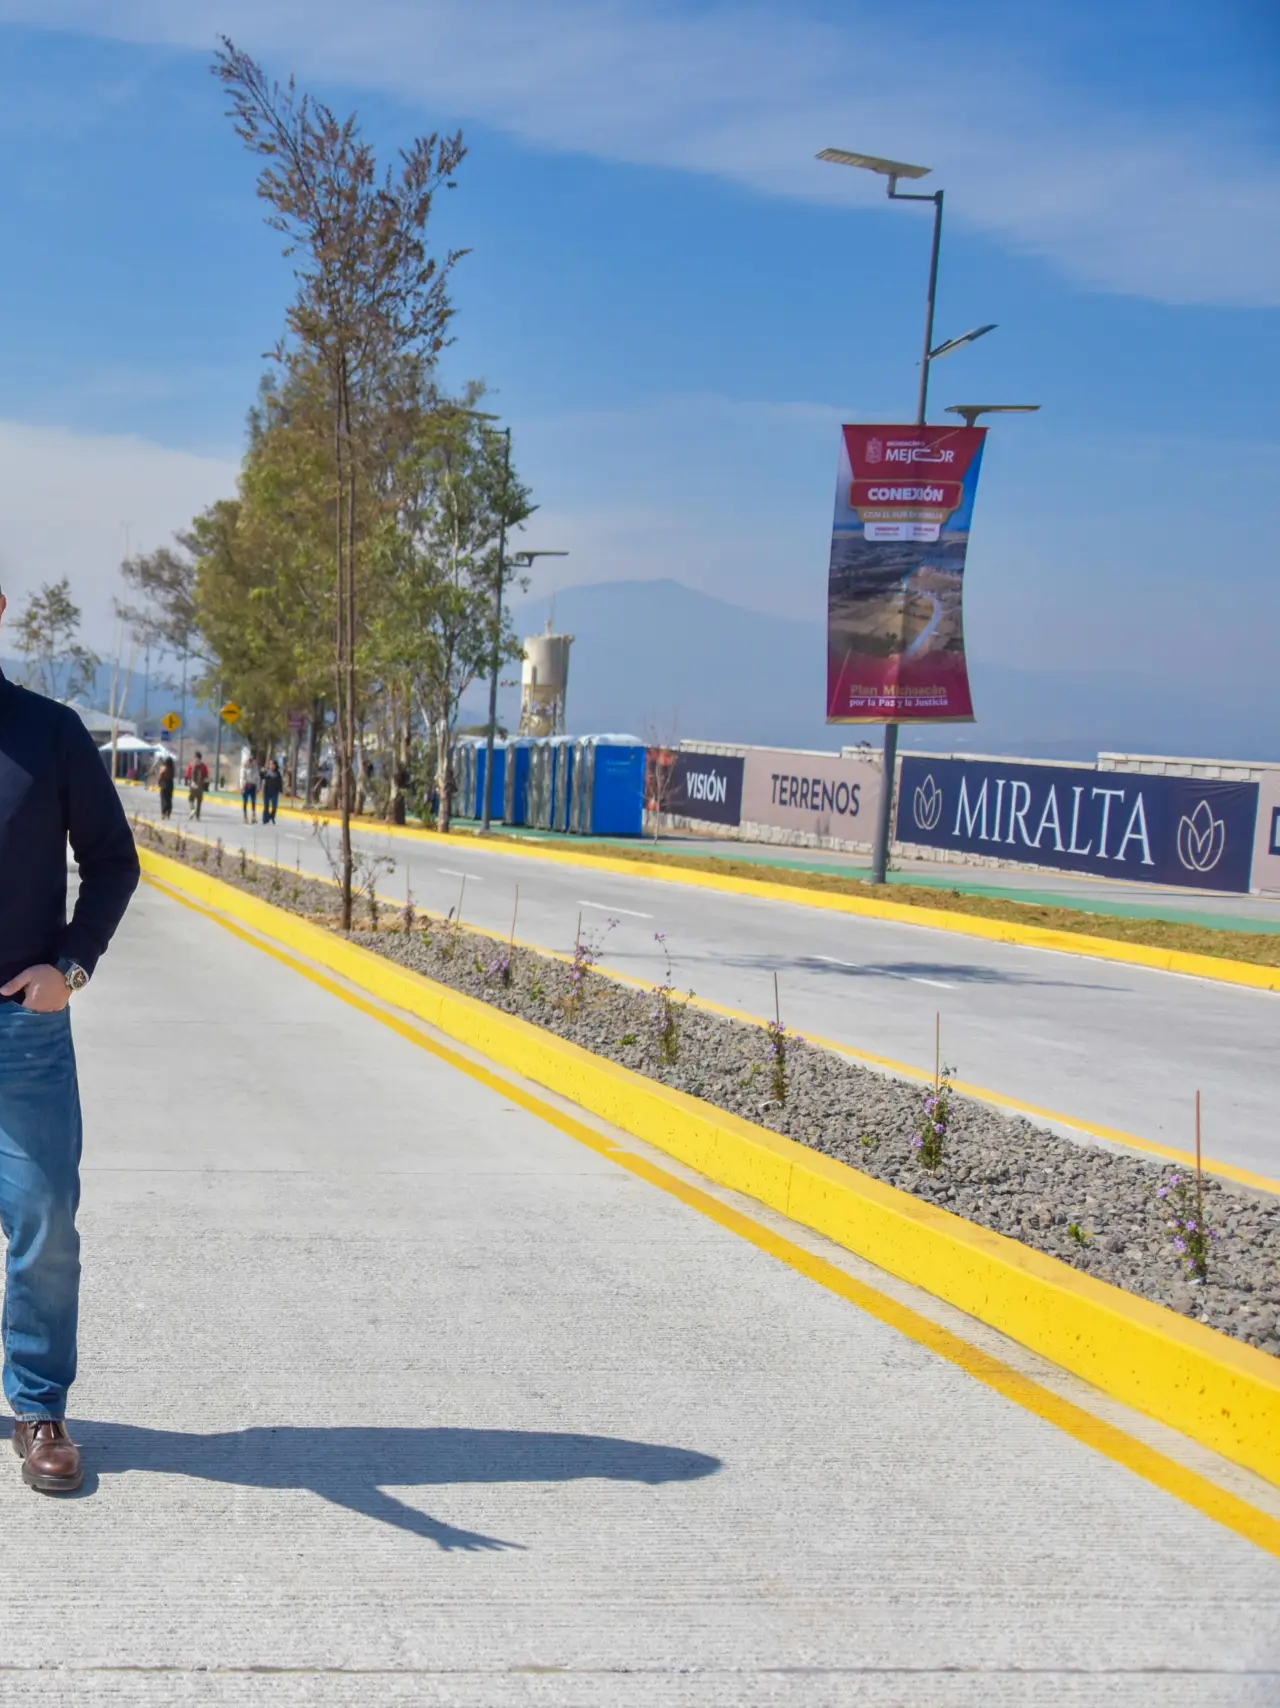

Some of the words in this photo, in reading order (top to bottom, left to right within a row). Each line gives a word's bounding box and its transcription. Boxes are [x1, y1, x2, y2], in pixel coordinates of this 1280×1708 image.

[867, 485, 944, 502] CONEXIÓN
[849, 699, 866, 708] por
[868, 698, 876, 707] la
[879, 698, 896, 707] Paz
[904, 698, 912, 707] la
[915, 698, 949, 707] Justicia
[850, 684, 878, 696] Plan
[883, 684, 947, 696] Michoacán
[686, 769, 727, 804] VISIÓN
[771, 773, 860, 818] TERRENOS
[951, 775, 1155, 866] MIRALTA
